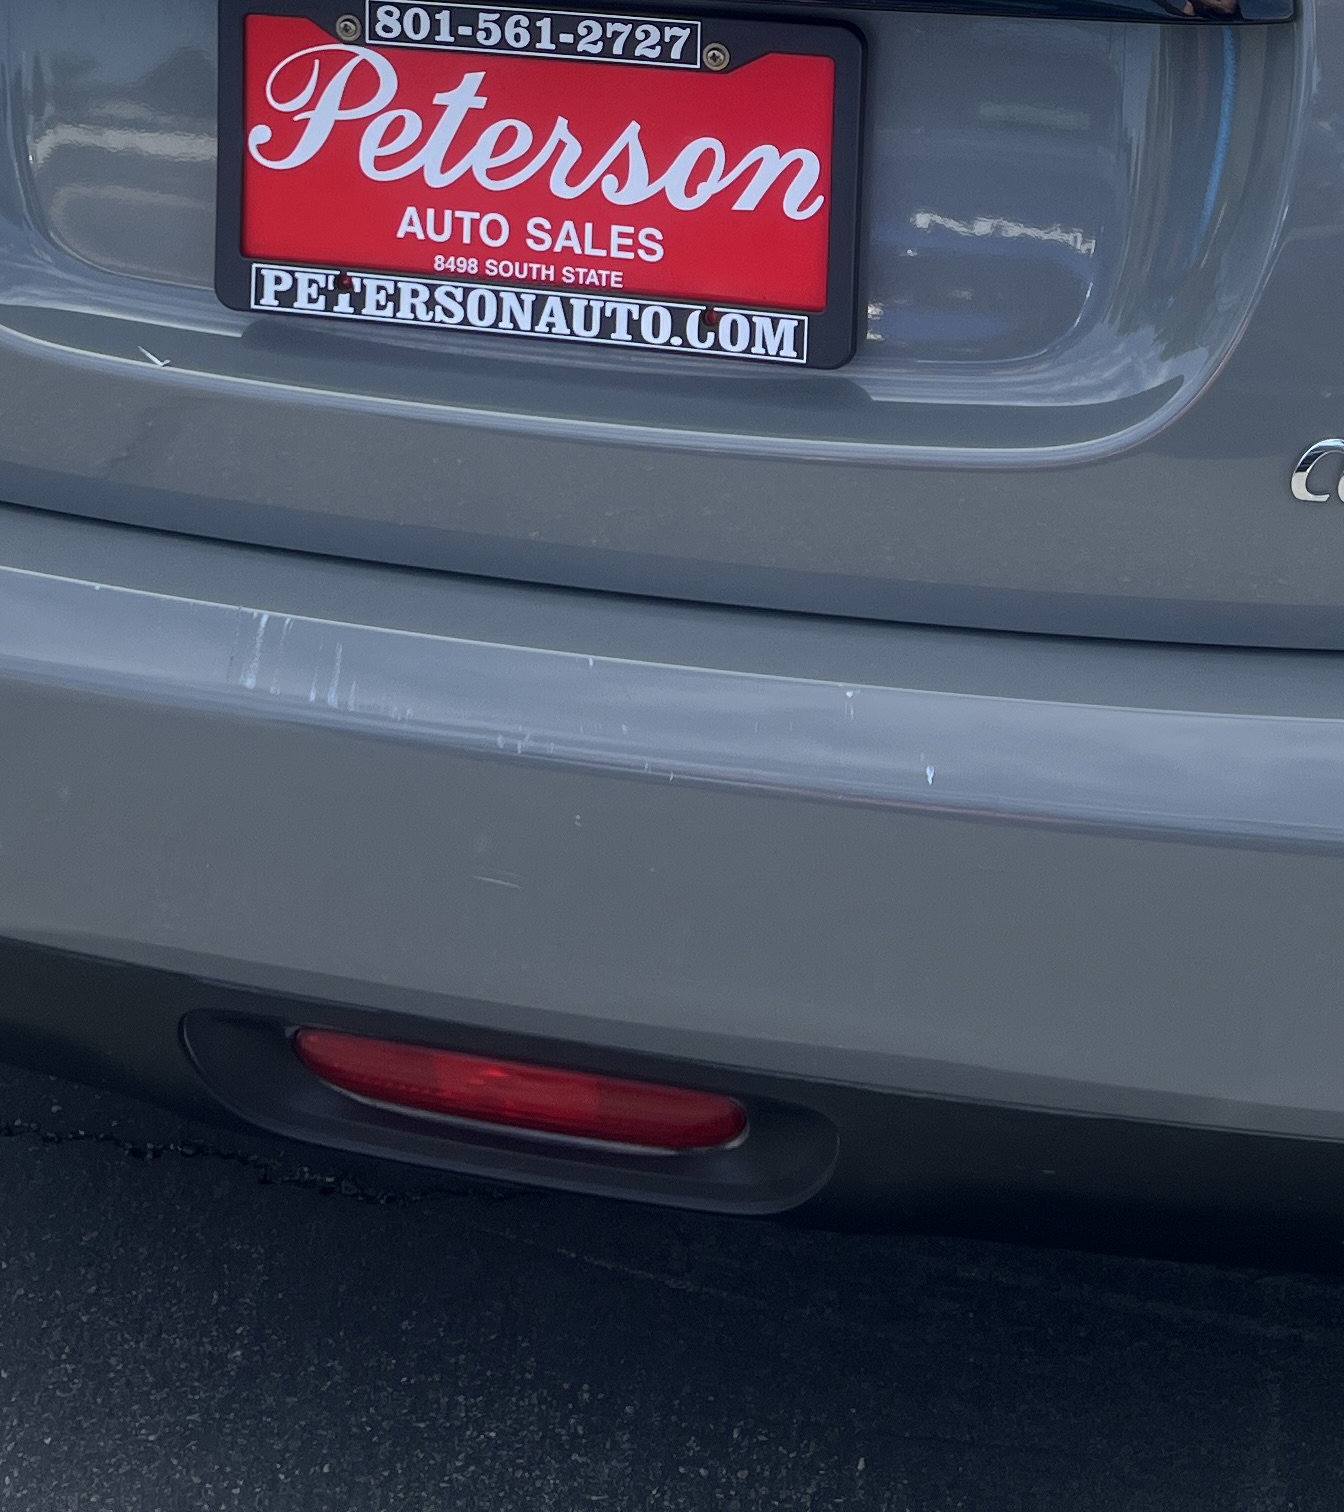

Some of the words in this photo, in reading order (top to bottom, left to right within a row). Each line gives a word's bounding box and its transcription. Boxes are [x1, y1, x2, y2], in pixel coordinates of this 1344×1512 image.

[375, 5, 692, 60] 801-561-2727
[248, 43, 824, 221] Peterson
[396, 205, 510, 249] AUTO
[525, 216, 665, 263] SALES
[432, 255, 479, 275] 8498
[484, 258, 556, 281] SOUTH
[561, 265, 623, 288] STATE
